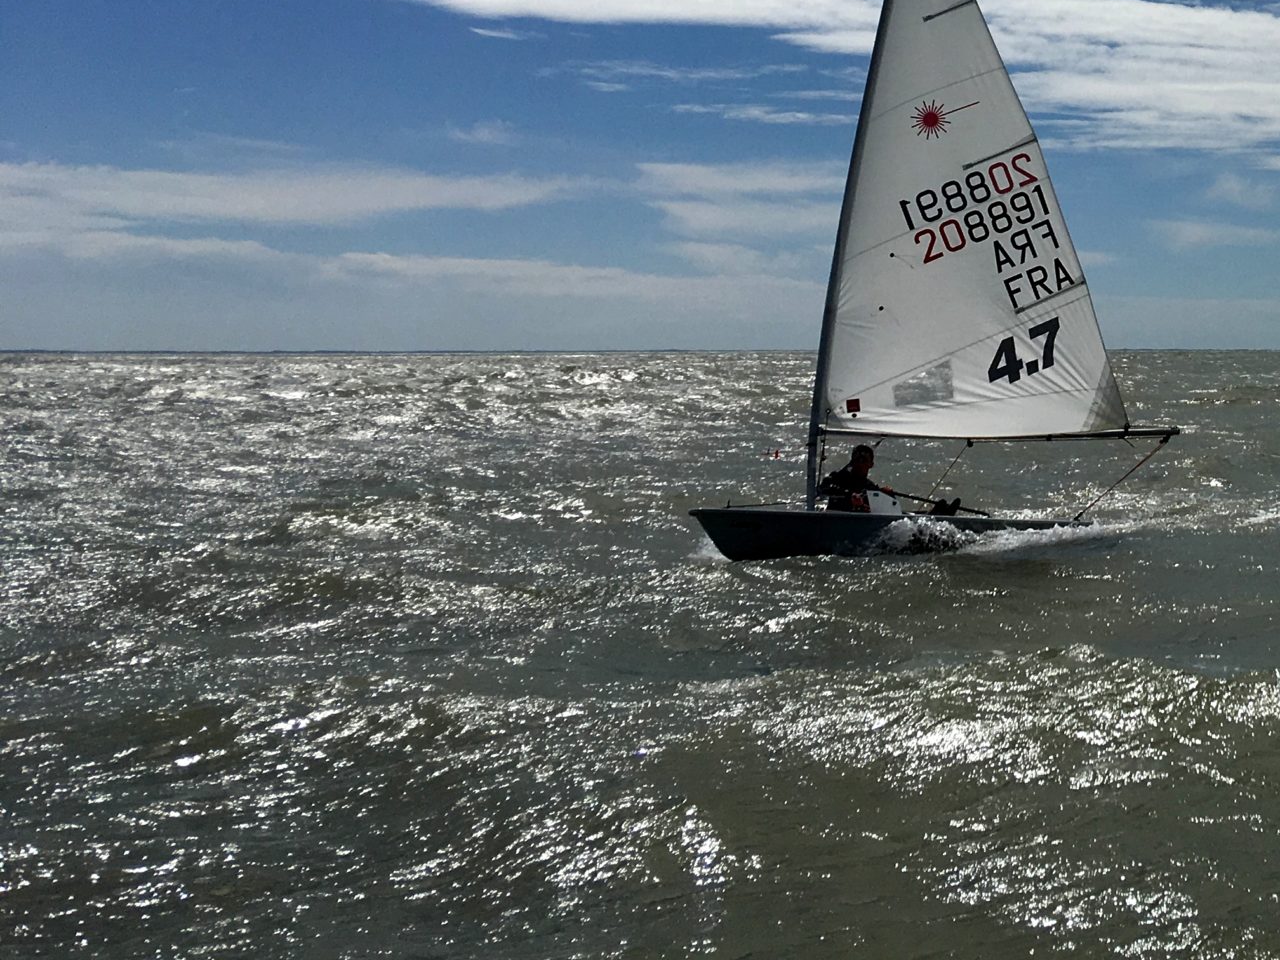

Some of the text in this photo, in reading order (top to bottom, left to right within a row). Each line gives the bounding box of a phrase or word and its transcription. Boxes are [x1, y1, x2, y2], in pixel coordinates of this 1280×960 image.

[914, 185, 1050, 264] 208891
[1004, 258, 1075, 309] FRA
[987, 317, 1061, 385] 4.7
